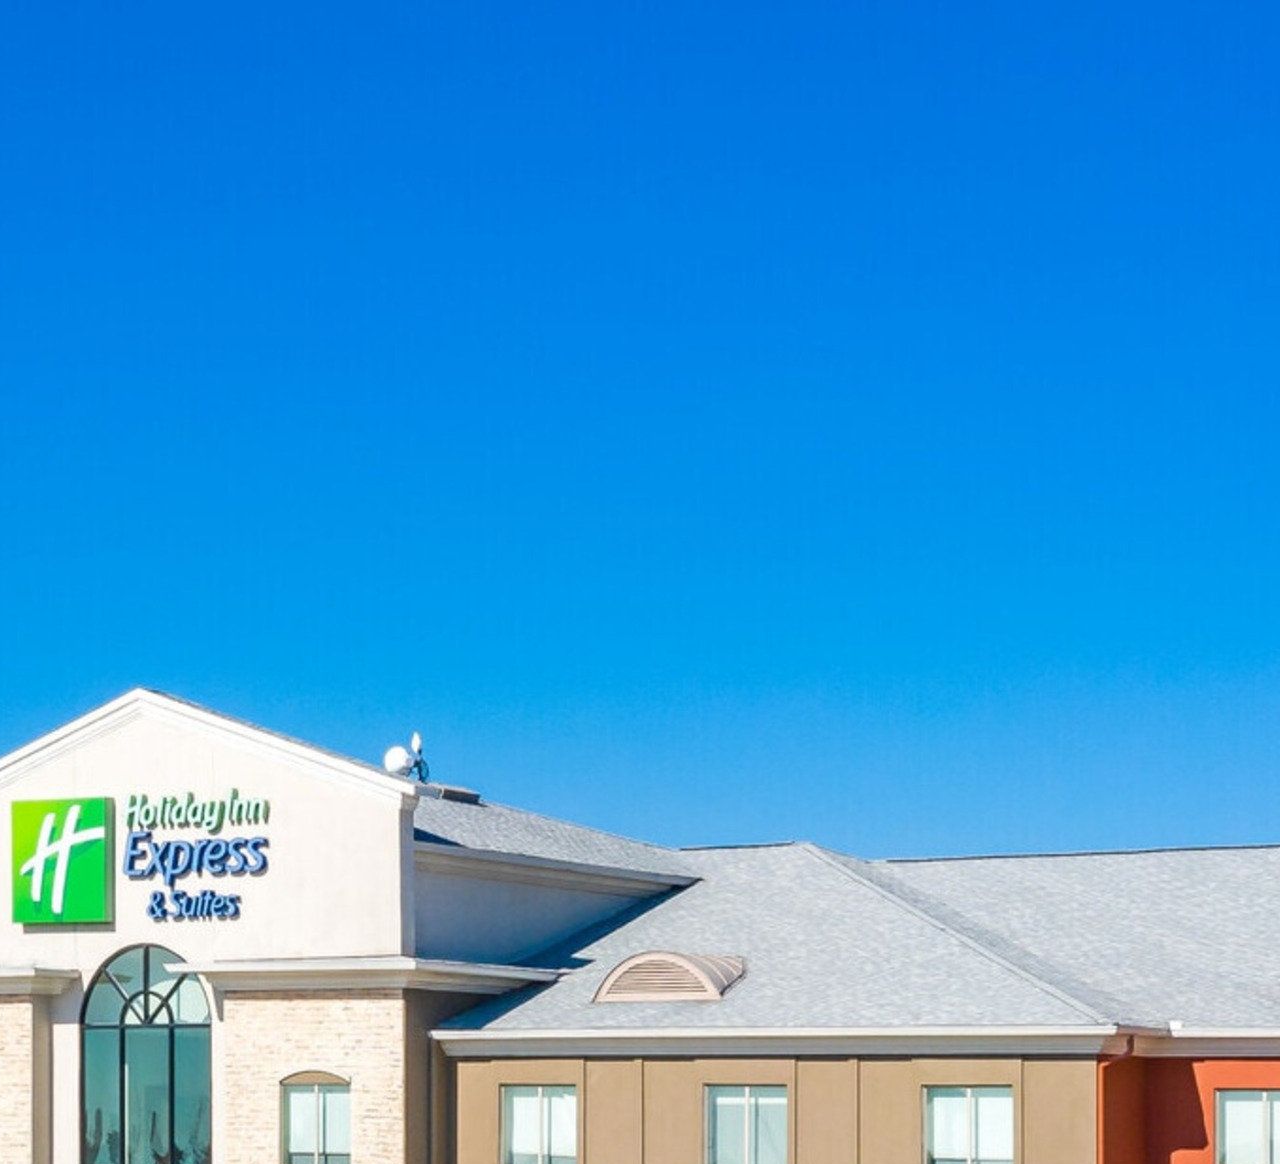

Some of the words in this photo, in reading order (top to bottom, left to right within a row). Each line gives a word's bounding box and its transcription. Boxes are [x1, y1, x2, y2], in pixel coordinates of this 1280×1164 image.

[124, 793, 224, 834] Holiday
[224, 788, 270, 826] Inn
[122, 830, 270, 889] Express
[147, 890, 169, 922] &
[169, 889, 242, 921] Suites
